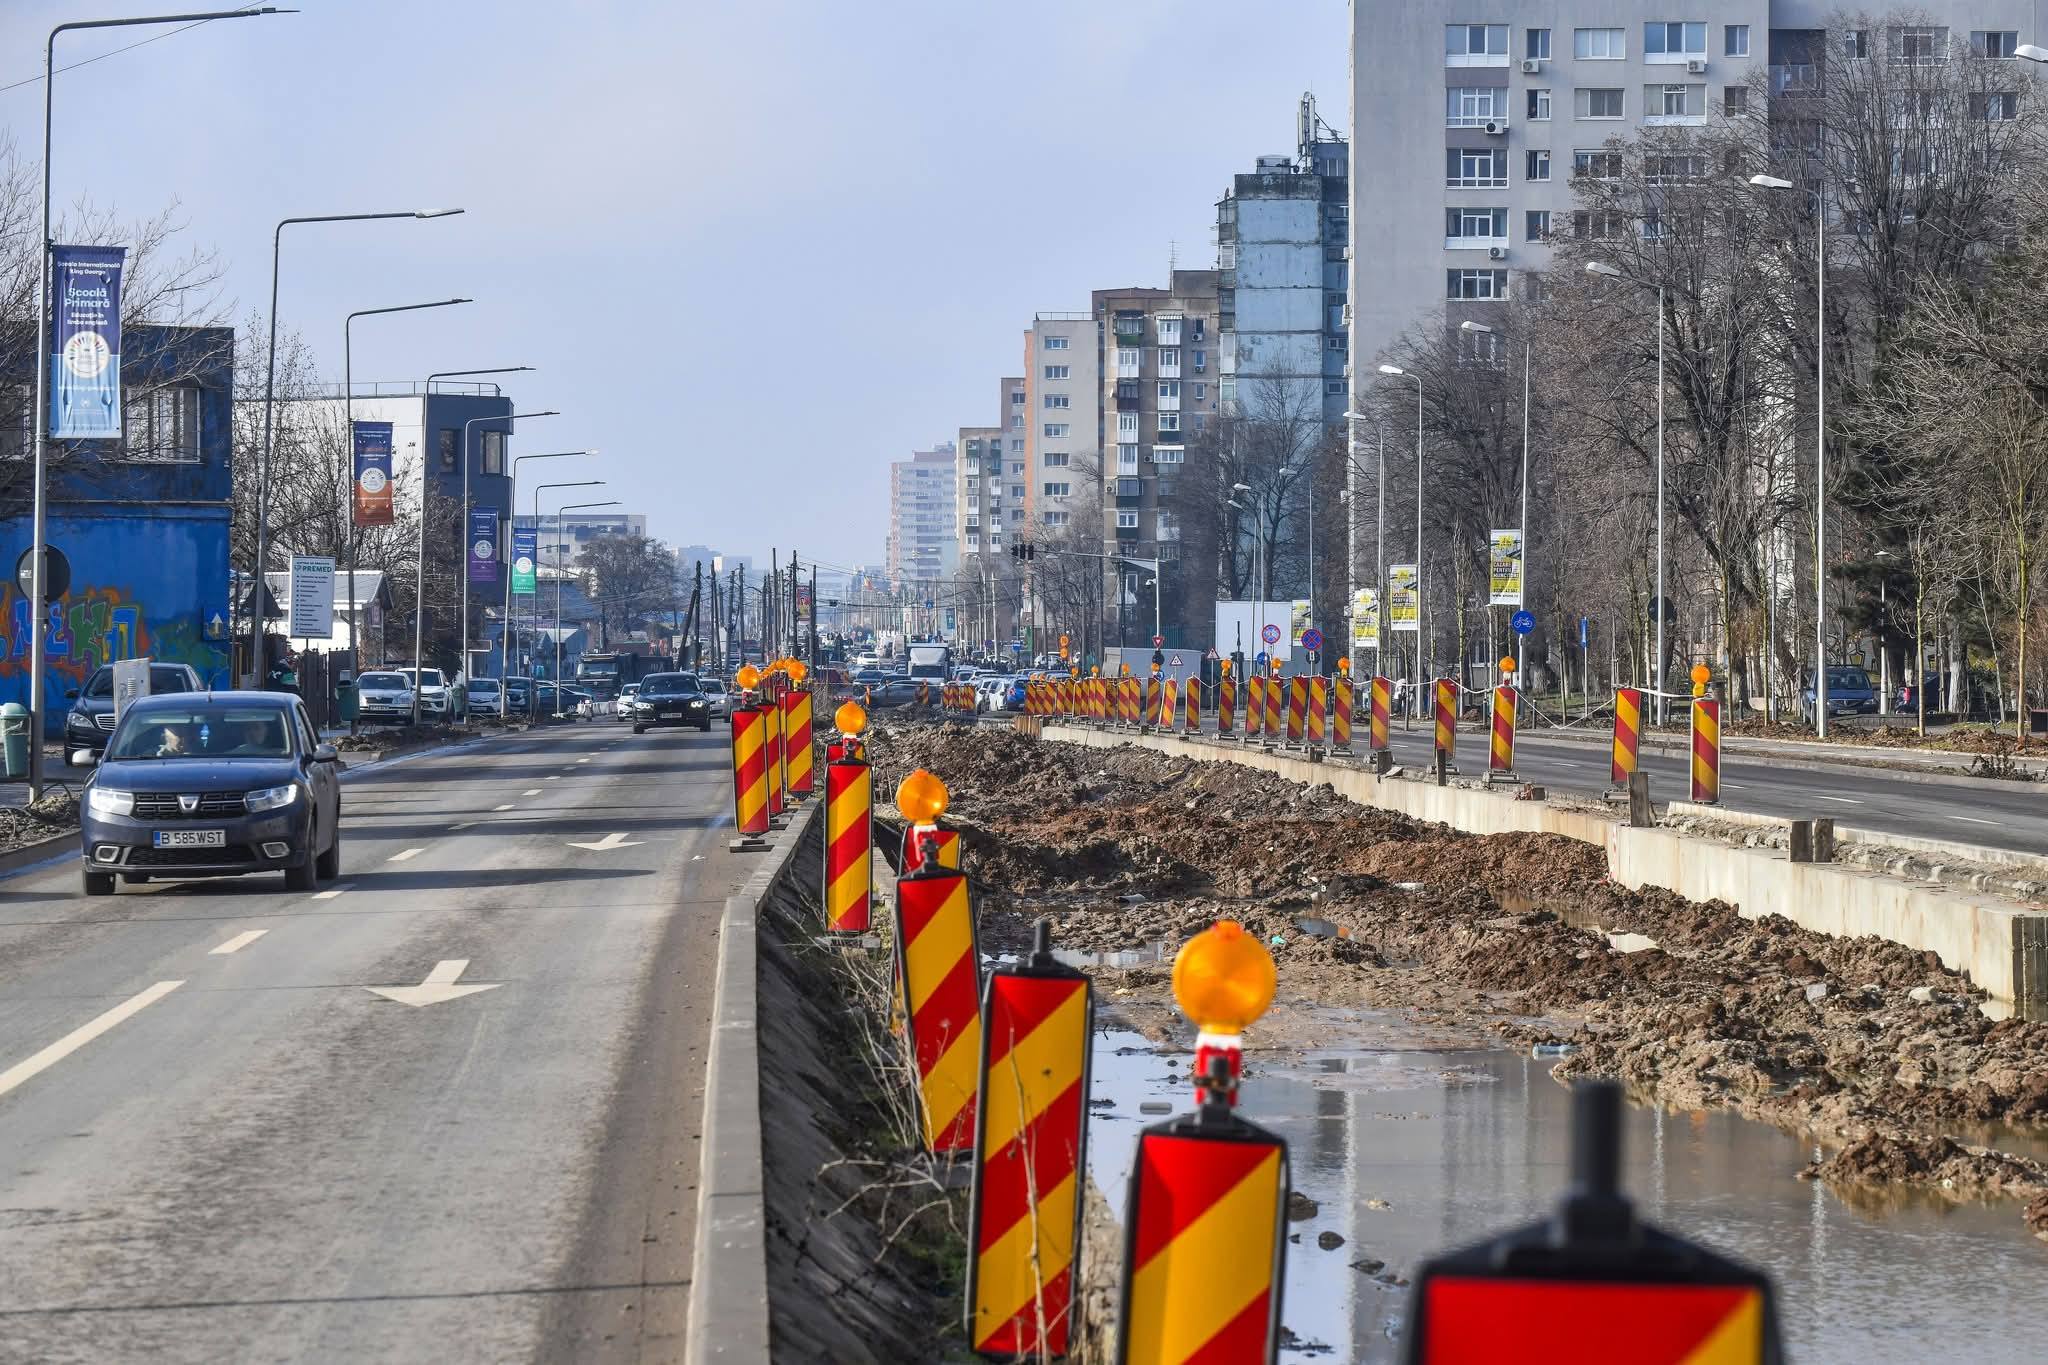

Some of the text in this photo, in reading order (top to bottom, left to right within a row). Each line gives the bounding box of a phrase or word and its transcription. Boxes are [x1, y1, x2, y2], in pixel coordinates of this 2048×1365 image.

[69, 287, 107, 299] Școală
[64, 298, 110, 308] Primară
[302, 565, 332, 573] PREMED
[161, 832, 170, 844] B
